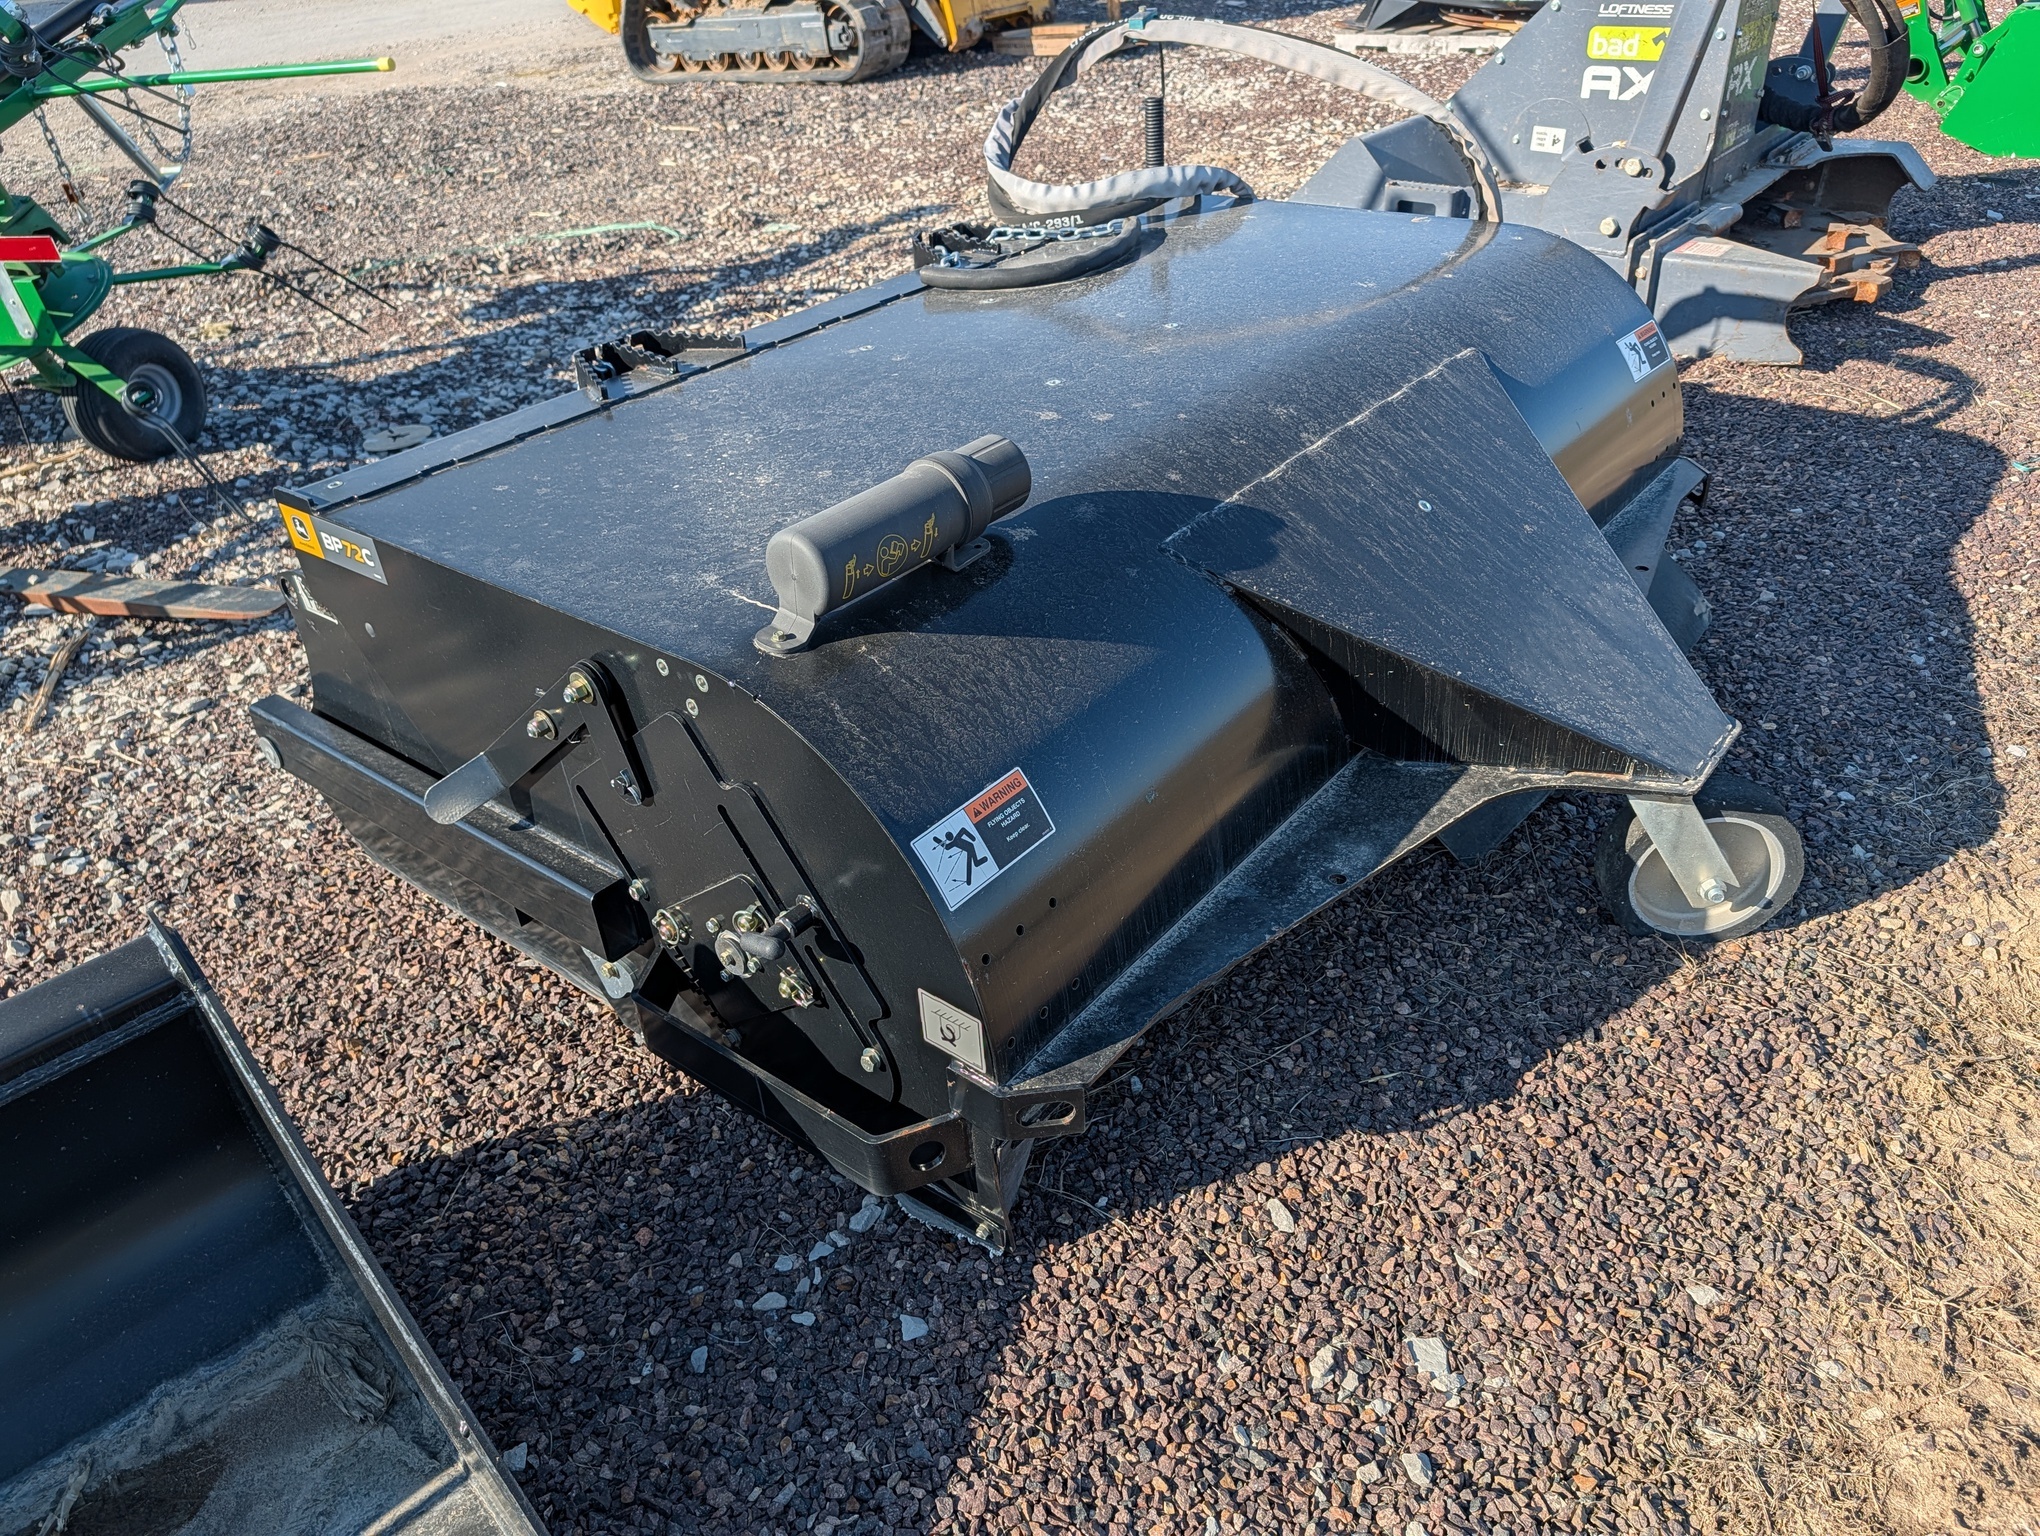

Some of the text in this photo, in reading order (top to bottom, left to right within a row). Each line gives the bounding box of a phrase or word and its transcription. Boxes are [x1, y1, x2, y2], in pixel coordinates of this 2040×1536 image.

[1598, 3, 1675, 15] LOFTNESS
[1591, 32, 1641, 57] bad
[1580, 65, 1656, 101] AX
[320, 531, 375, 567] BP72C
[979, 777, 1022, 812] WARNING
[987, 797, 1026, 828] FLYING OBJECTS
[1000, 810, 1021, 828] HAZARD
[1006, 831, 1019, 843] Keep
